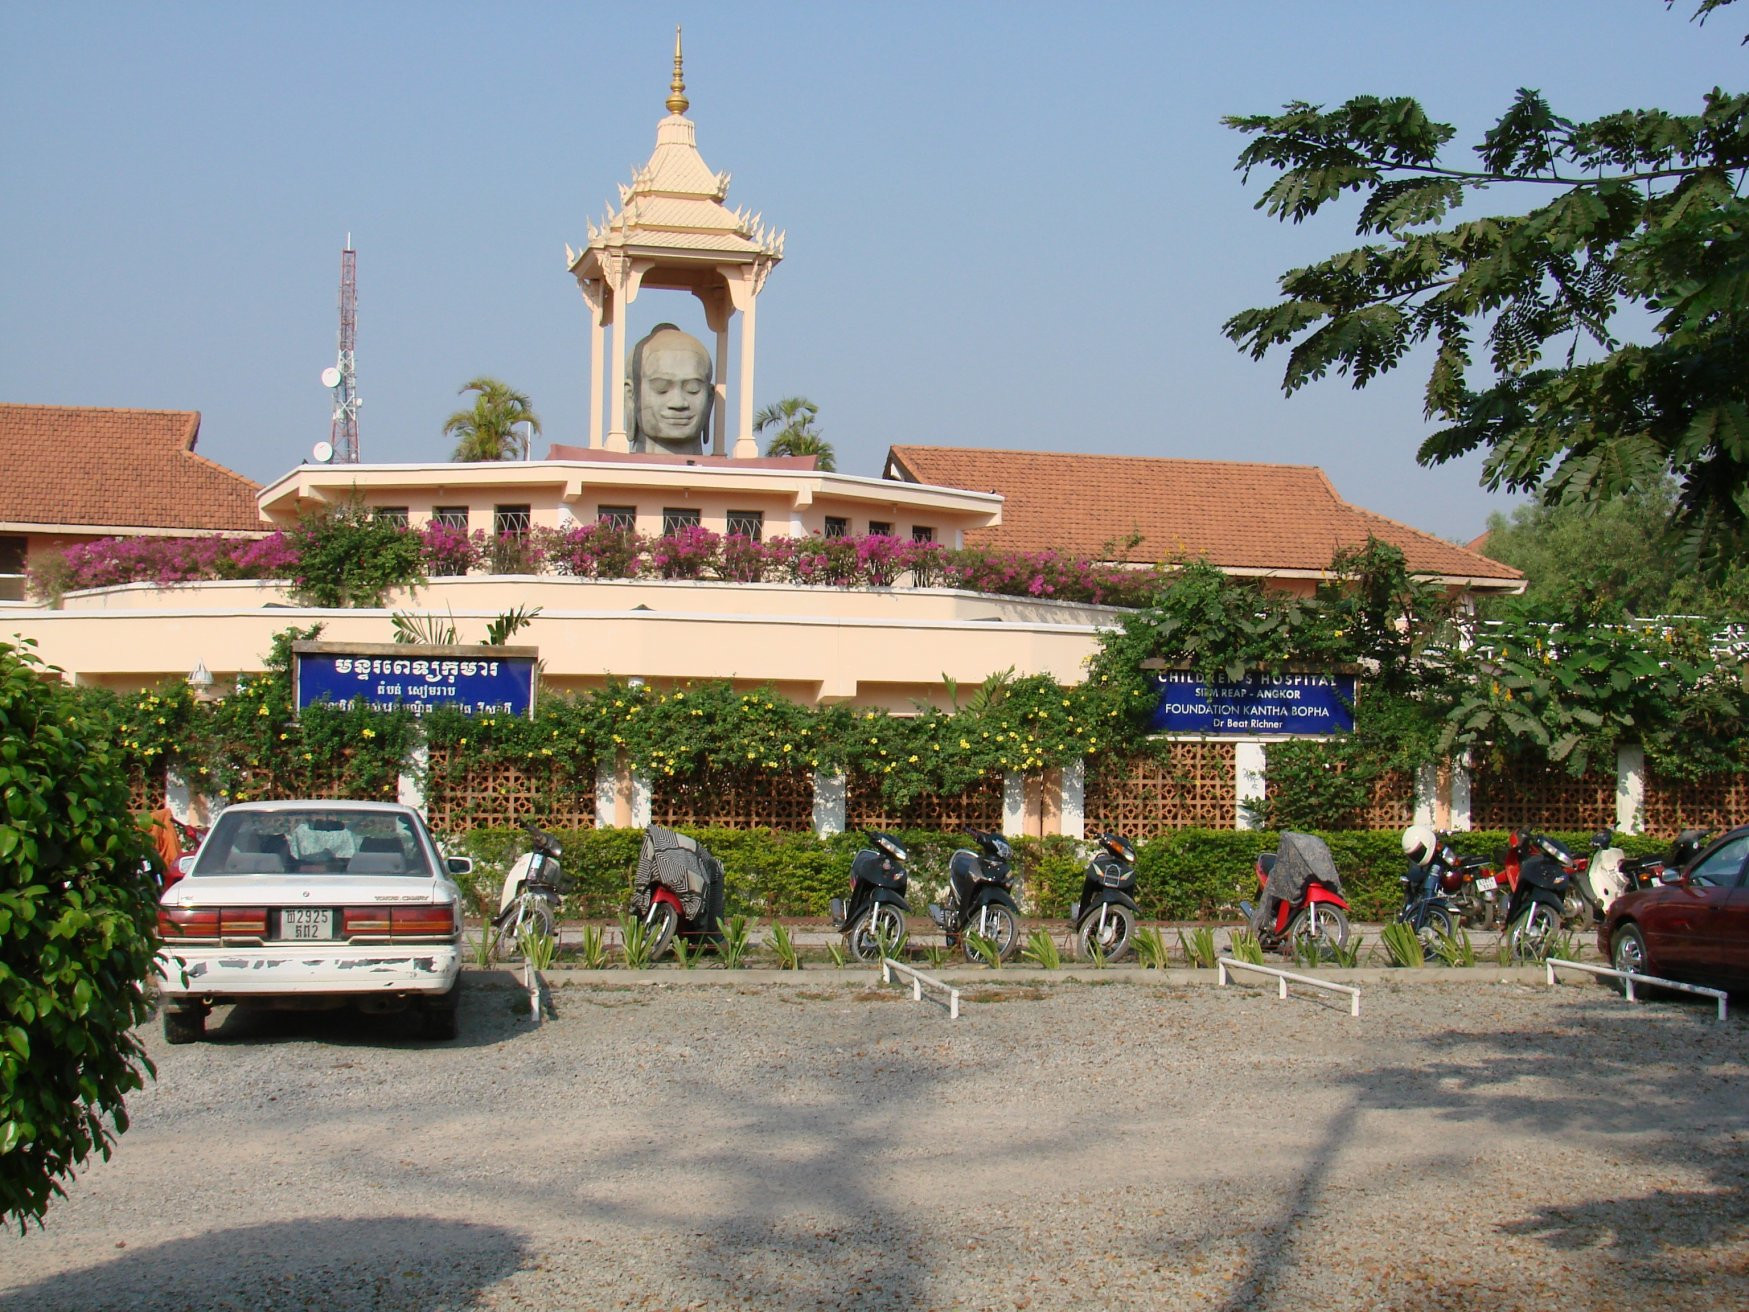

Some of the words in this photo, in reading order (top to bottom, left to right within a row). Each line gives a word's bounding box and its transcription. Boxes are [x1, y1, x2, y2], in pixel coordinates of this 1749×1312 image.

[1158, 670, 1253, 684] CHILDES
[1260, 673, 1337, 686] HOSPITAL
[1221, 688, 1247, 698] REAP
[1256, 689, 1301, 699] ANGKOR
[1165, 703, 1240, 715] FOUNDATION
[1243, 704, 1288, 717] KANTHA
[1291, 706, 1330, 717] BOPHA
[1213, 718, 1224, 727] Dr
[1227, 718, 1248, 728] Beat
[1250, 719, 1283, 728] Richner
